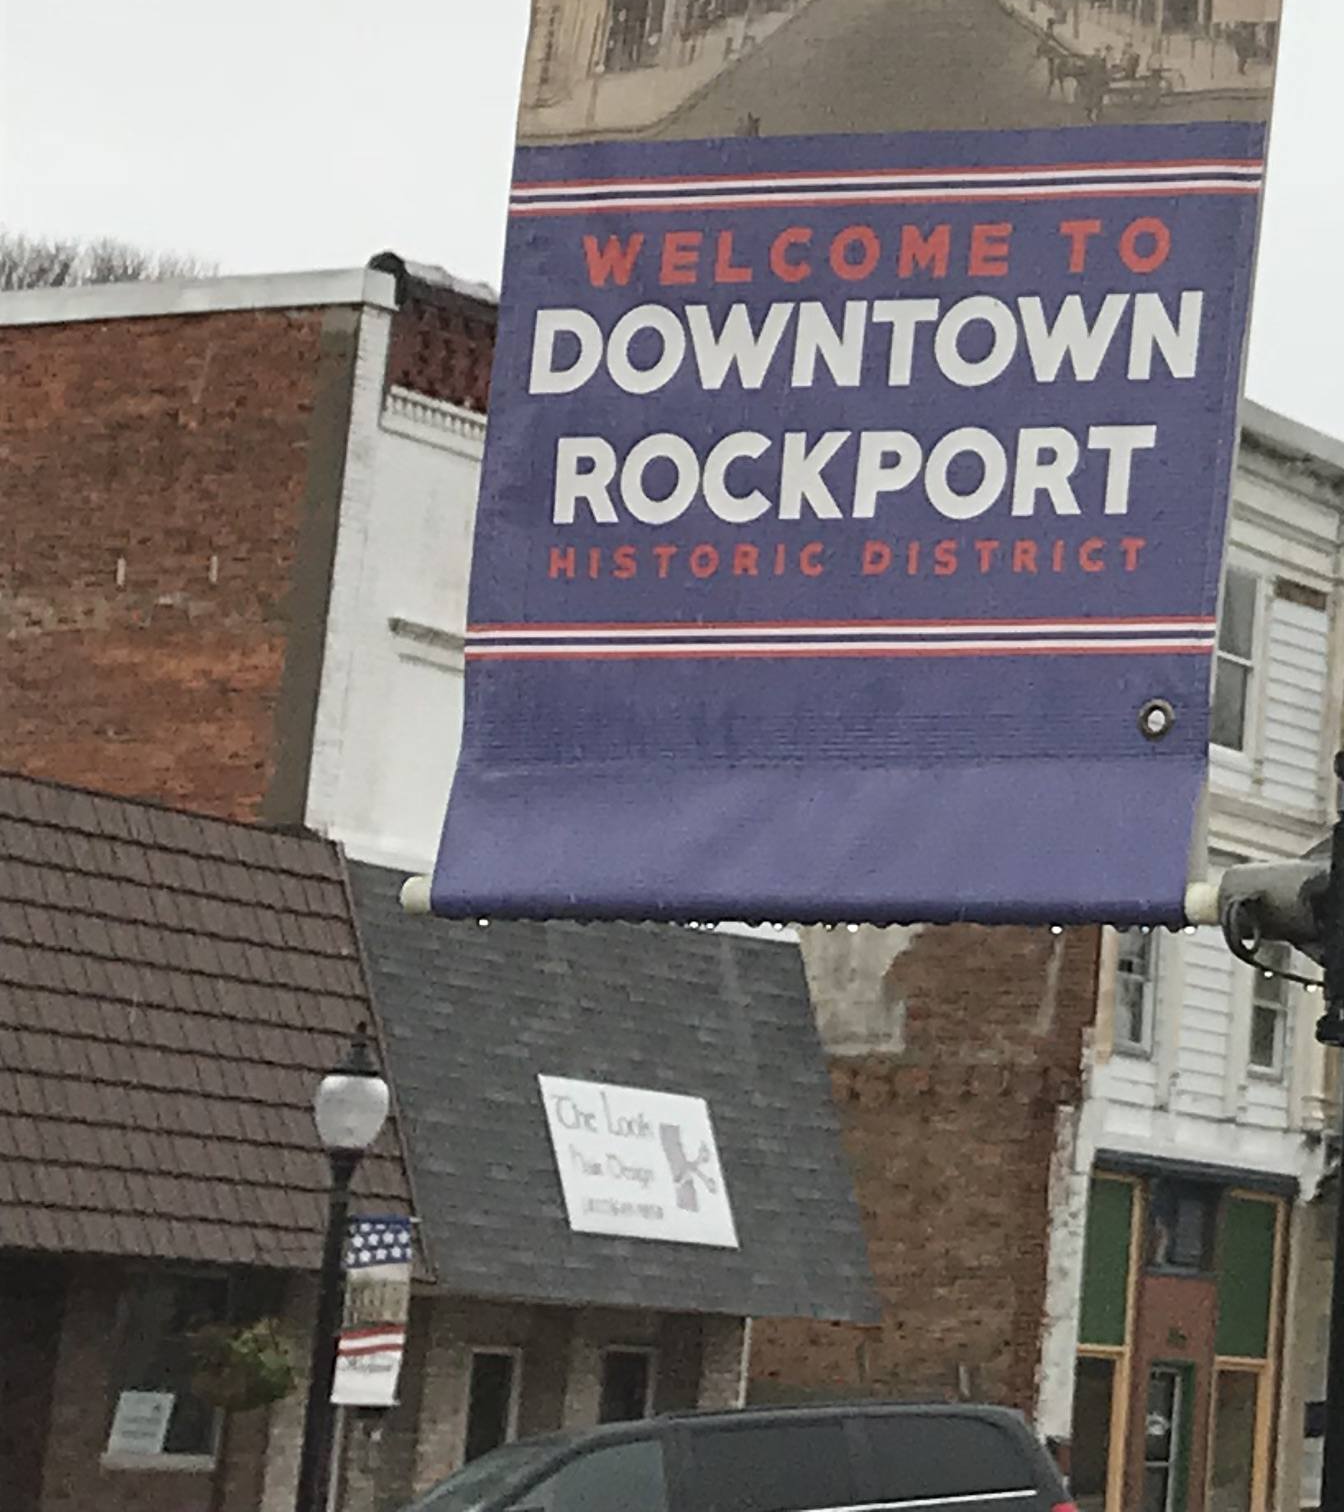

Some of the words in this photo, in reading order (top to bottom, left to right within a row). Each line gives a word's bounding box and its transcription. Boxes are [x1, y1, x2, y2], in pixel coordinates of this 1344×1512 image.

[583, 222, 1014, 286] WELCOME
[1060, 216, 1172, 274] TO
[528, 290, 1204, 396] DOWNTOWN
[552, 425, 1157, 525] ROCKPORT
[548, 541, 825, 580] HISTORIC
[862, 537, 1147, 576] DISTRICT
